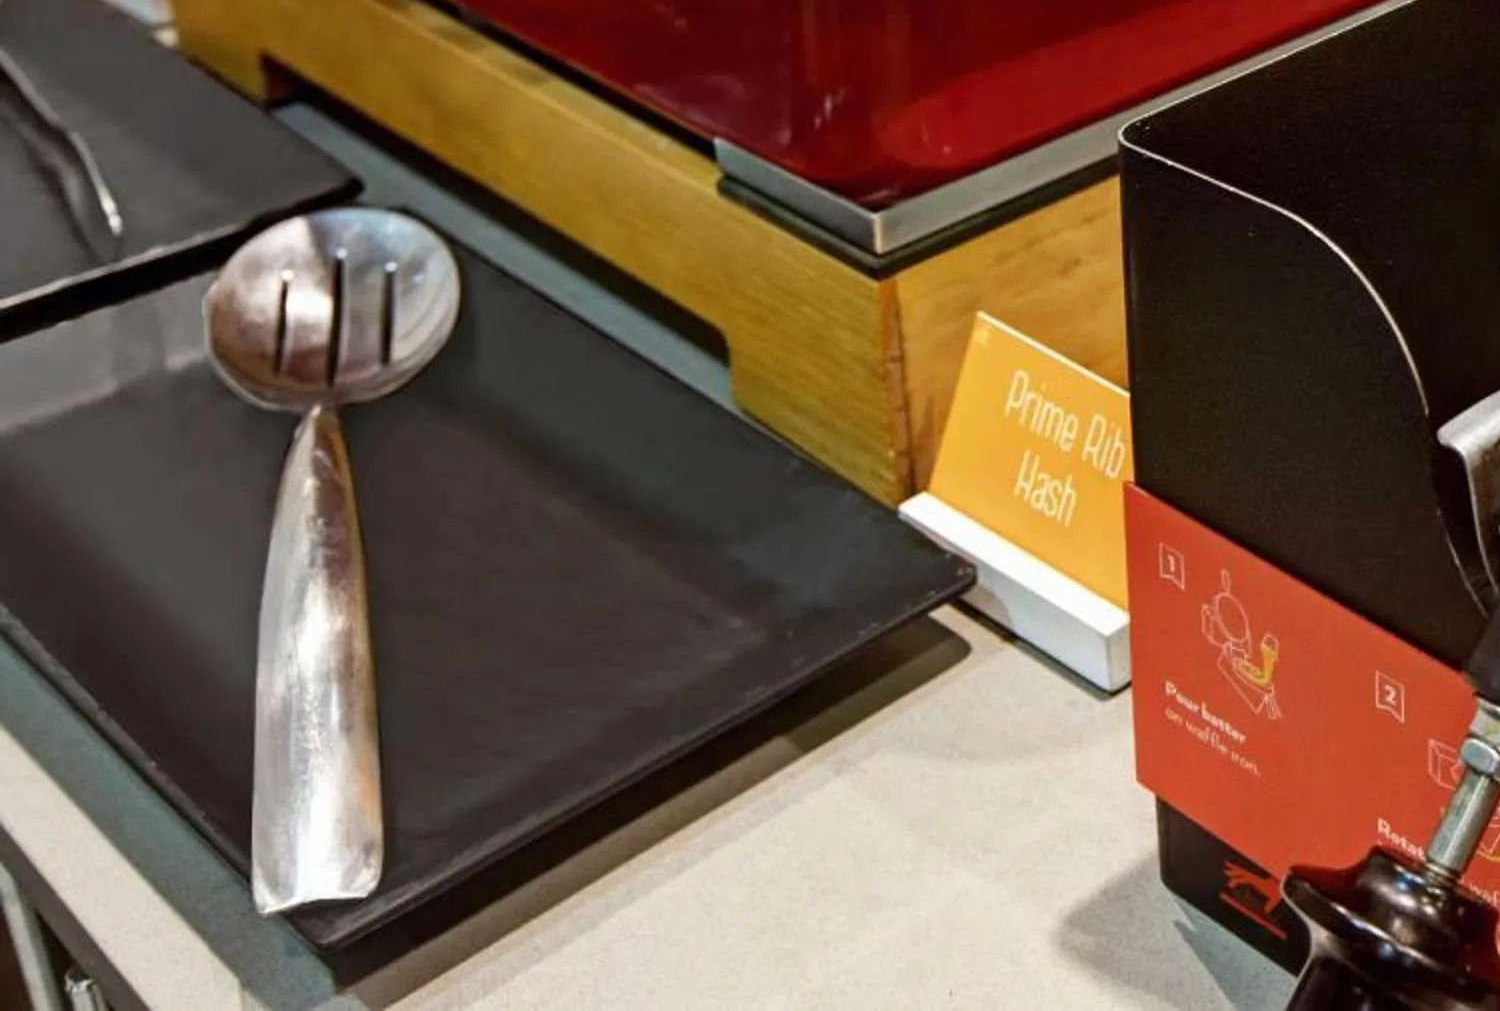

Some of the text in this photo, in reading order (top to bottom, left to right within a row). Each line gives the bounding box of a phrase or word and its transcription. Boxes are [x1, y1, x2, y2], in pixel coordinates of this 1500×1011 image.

[1004, 369, 1125, 478] Prime Rib
[1013, 449, 1077, 527] Hash
[1165, 680, 1200, 712] Pour
[1384, 684, 1397, 705] 2
[1165, 708, 1183, 725] on
[1186, 720, 1228, 755] waffle
[1377, 817, 1427, 862] Rotat
